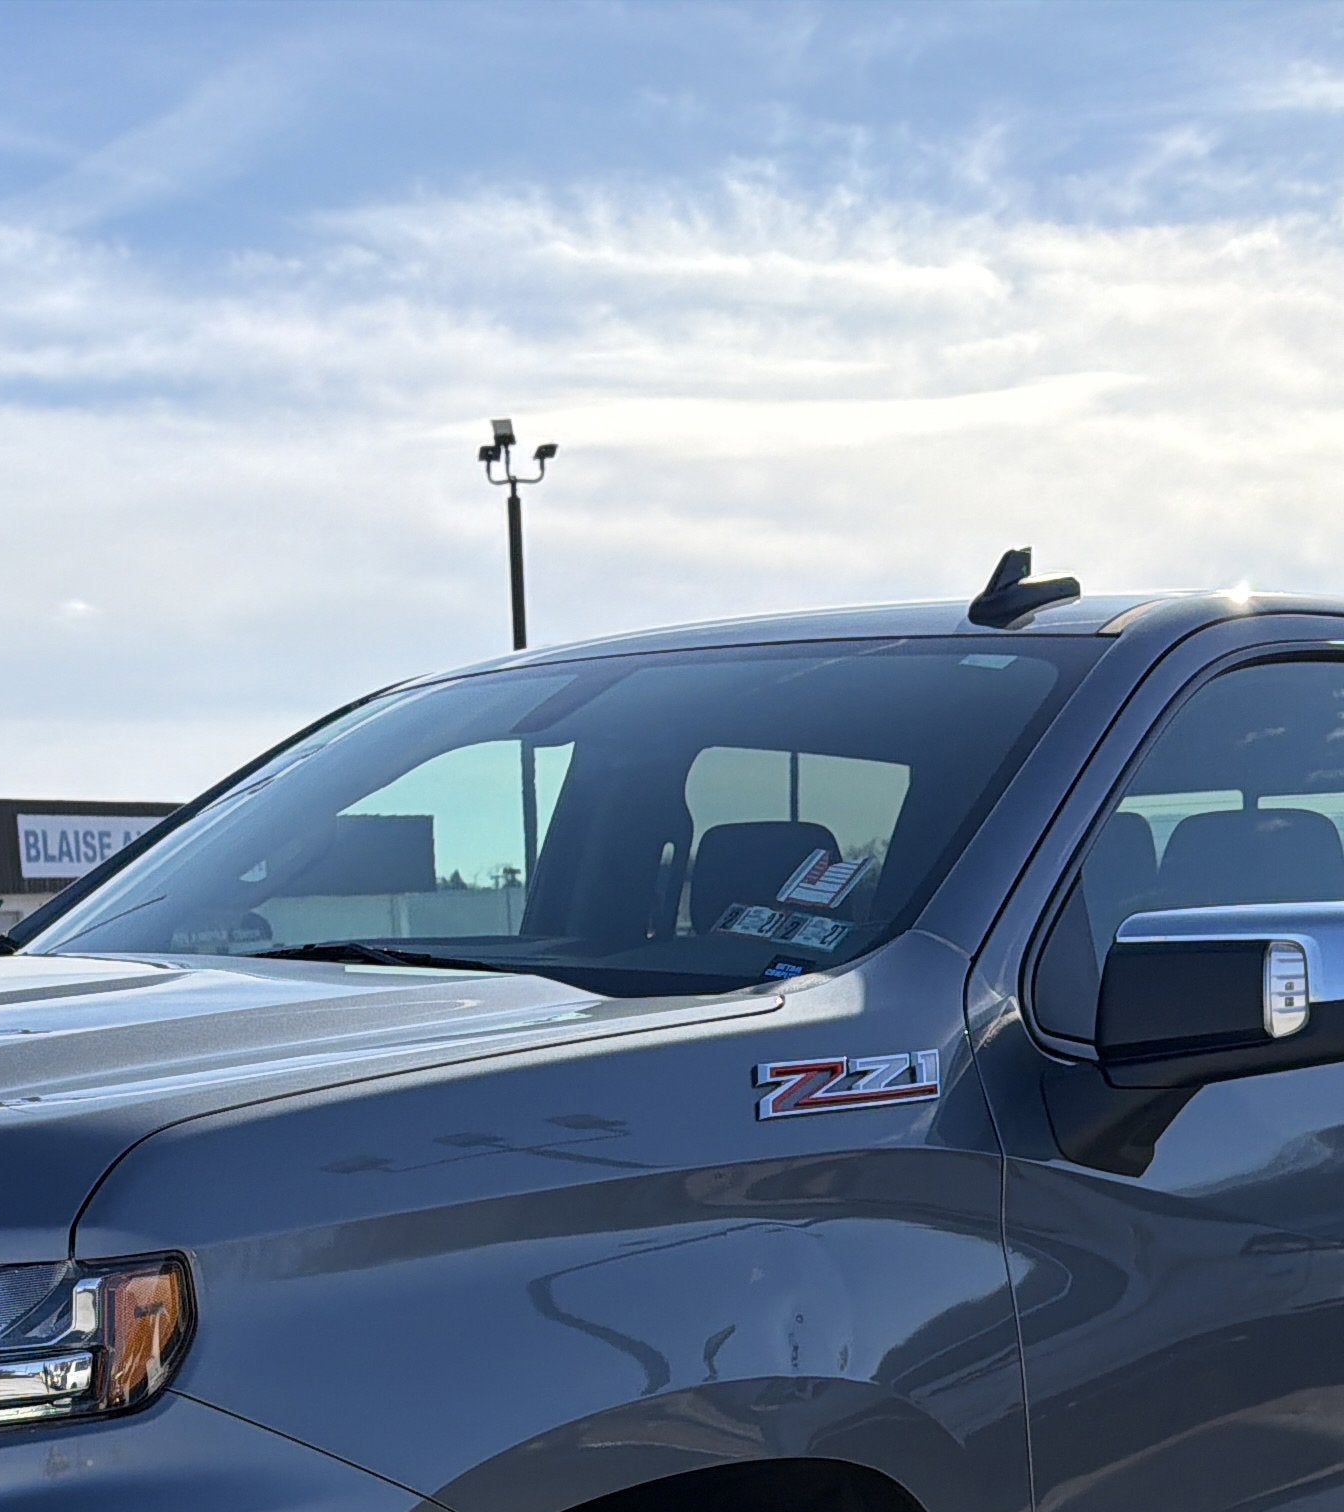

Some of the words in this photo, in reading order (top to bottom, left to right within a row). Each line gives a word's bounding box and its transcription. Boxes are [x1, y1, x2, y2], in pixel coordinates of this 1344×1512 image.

[23, 829, 112, 863] BLAISE
[819, 924, 848, 946] 27
[752, 1049, 940, 1121] Z71
